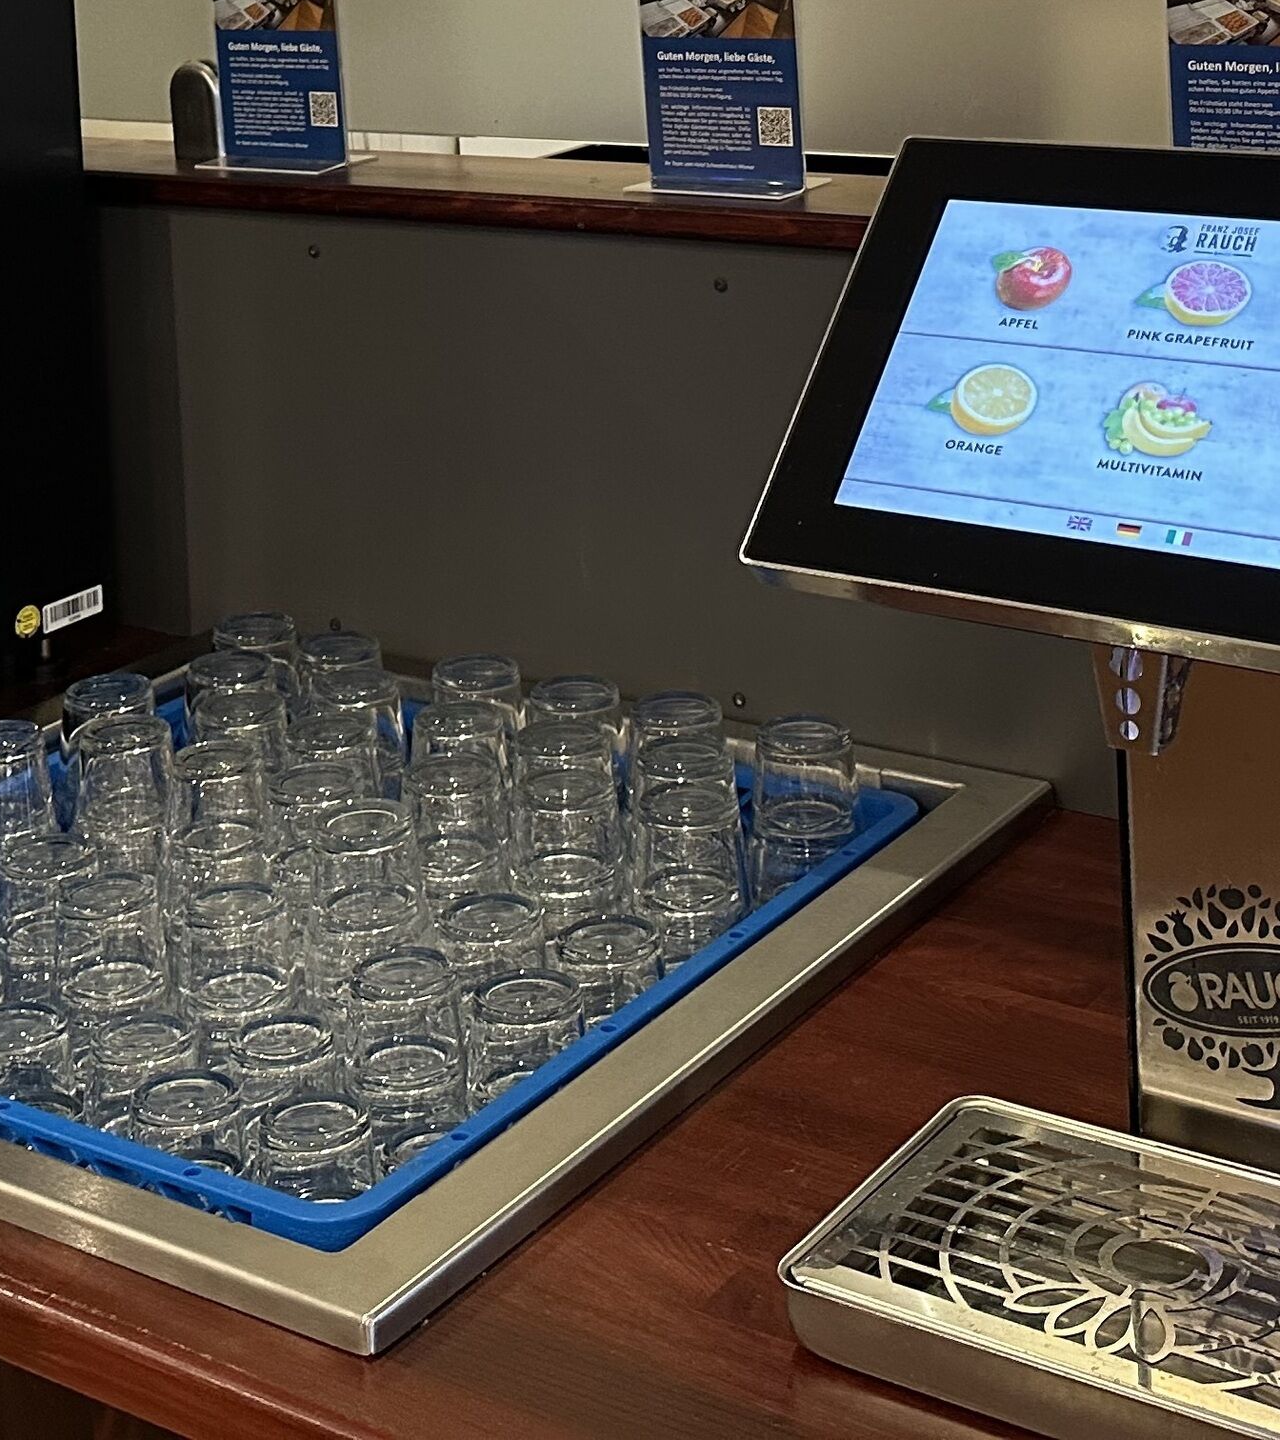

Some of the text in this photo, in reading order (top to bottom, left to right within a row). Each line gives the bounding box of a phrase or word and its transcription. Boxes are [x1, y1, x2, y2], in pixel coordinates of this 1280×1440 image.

[657, 51, 776, 64] Guten Morgen, liebe Gäste,
[1187, 60, 1222, 71] Guten
[1225, 61, 1273, 74] Morgen,
[1195, 232, 1258, 252] RAUCH
[998, 316, 1039, 330] APFEL
[1126, 329, 1255, 351] PINK GRAPEFRUIT
[945, 439, 1004, 456] ORANGE
[1096, 458, 1204, 483] MULTIVITAMIN
